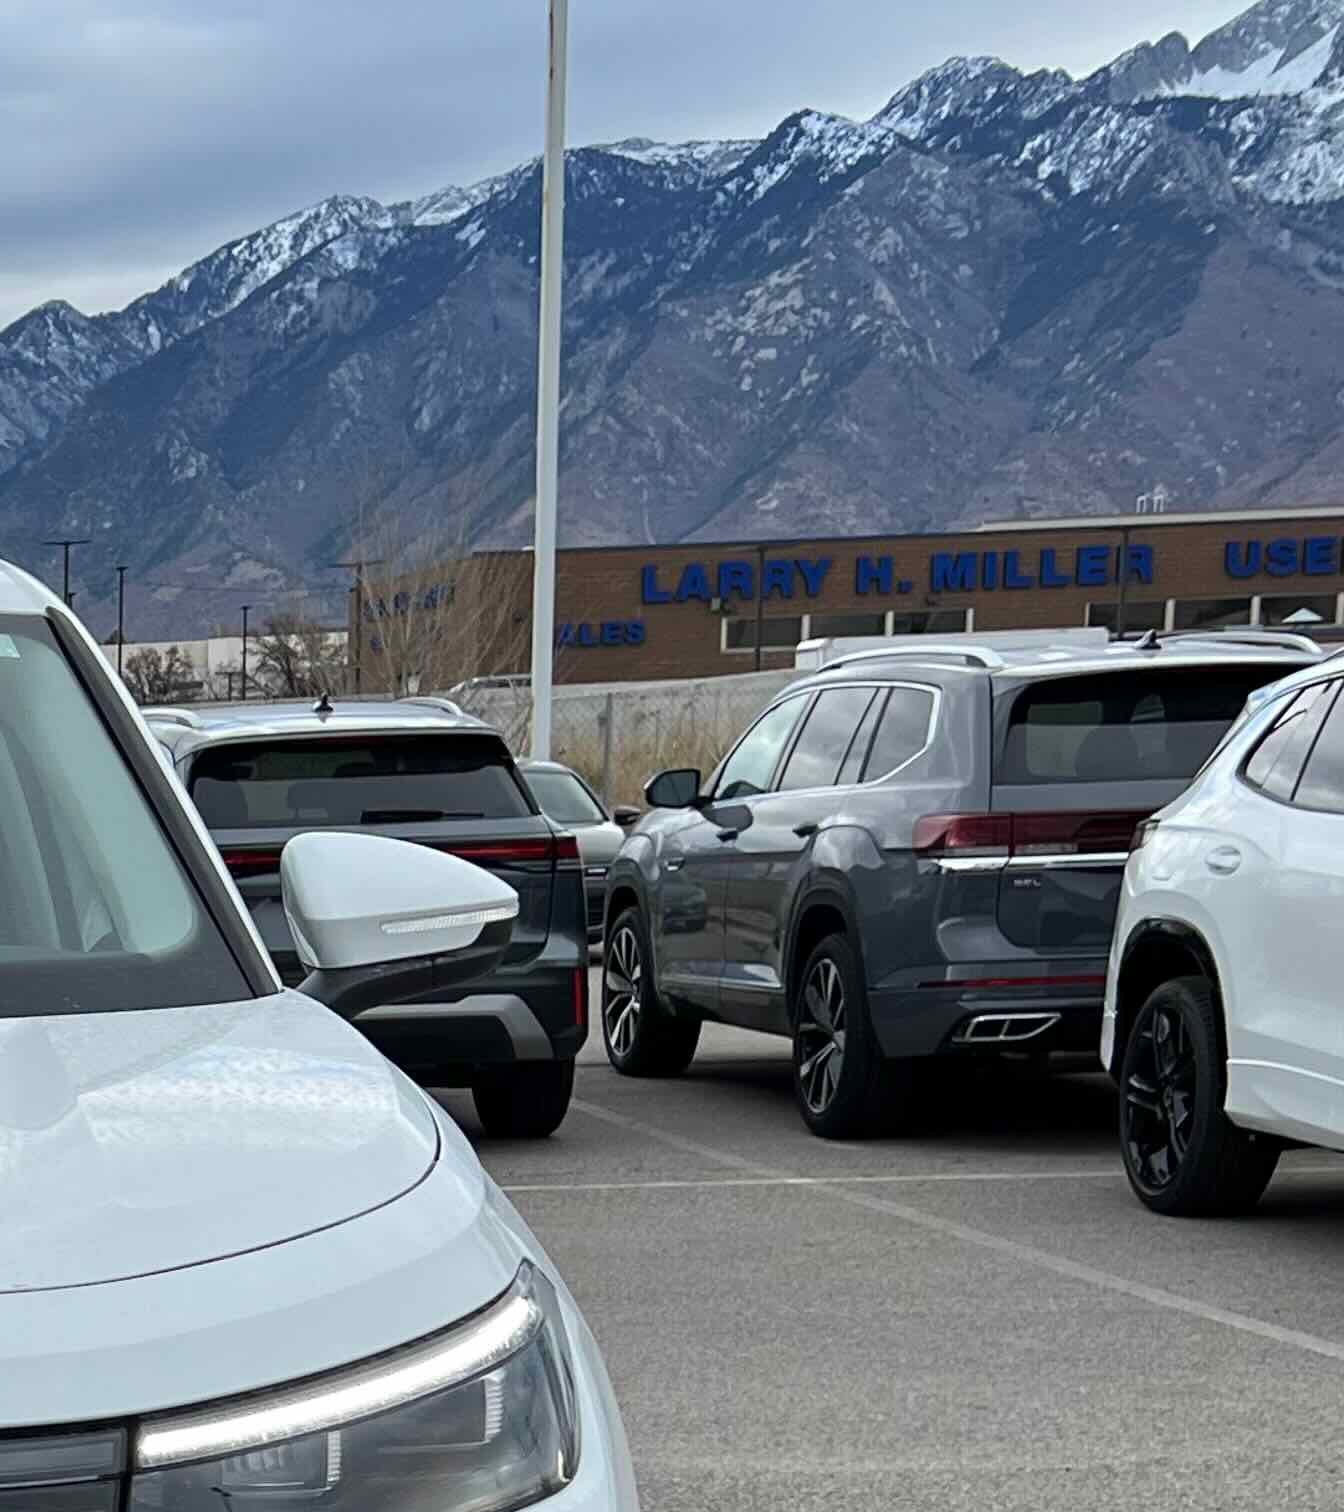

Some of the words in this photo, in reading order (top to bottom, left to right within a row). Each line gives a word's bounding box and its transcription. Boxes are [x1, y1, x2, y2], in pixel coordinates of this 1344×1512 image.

[642, 556, 834, 604] LARRY
[855, 553, 912, 594] H.
[929, 543, 1154, 593] MILLER
[1224, 537, 1344, 577] USE
[556, 618, 645, 646] ALES
